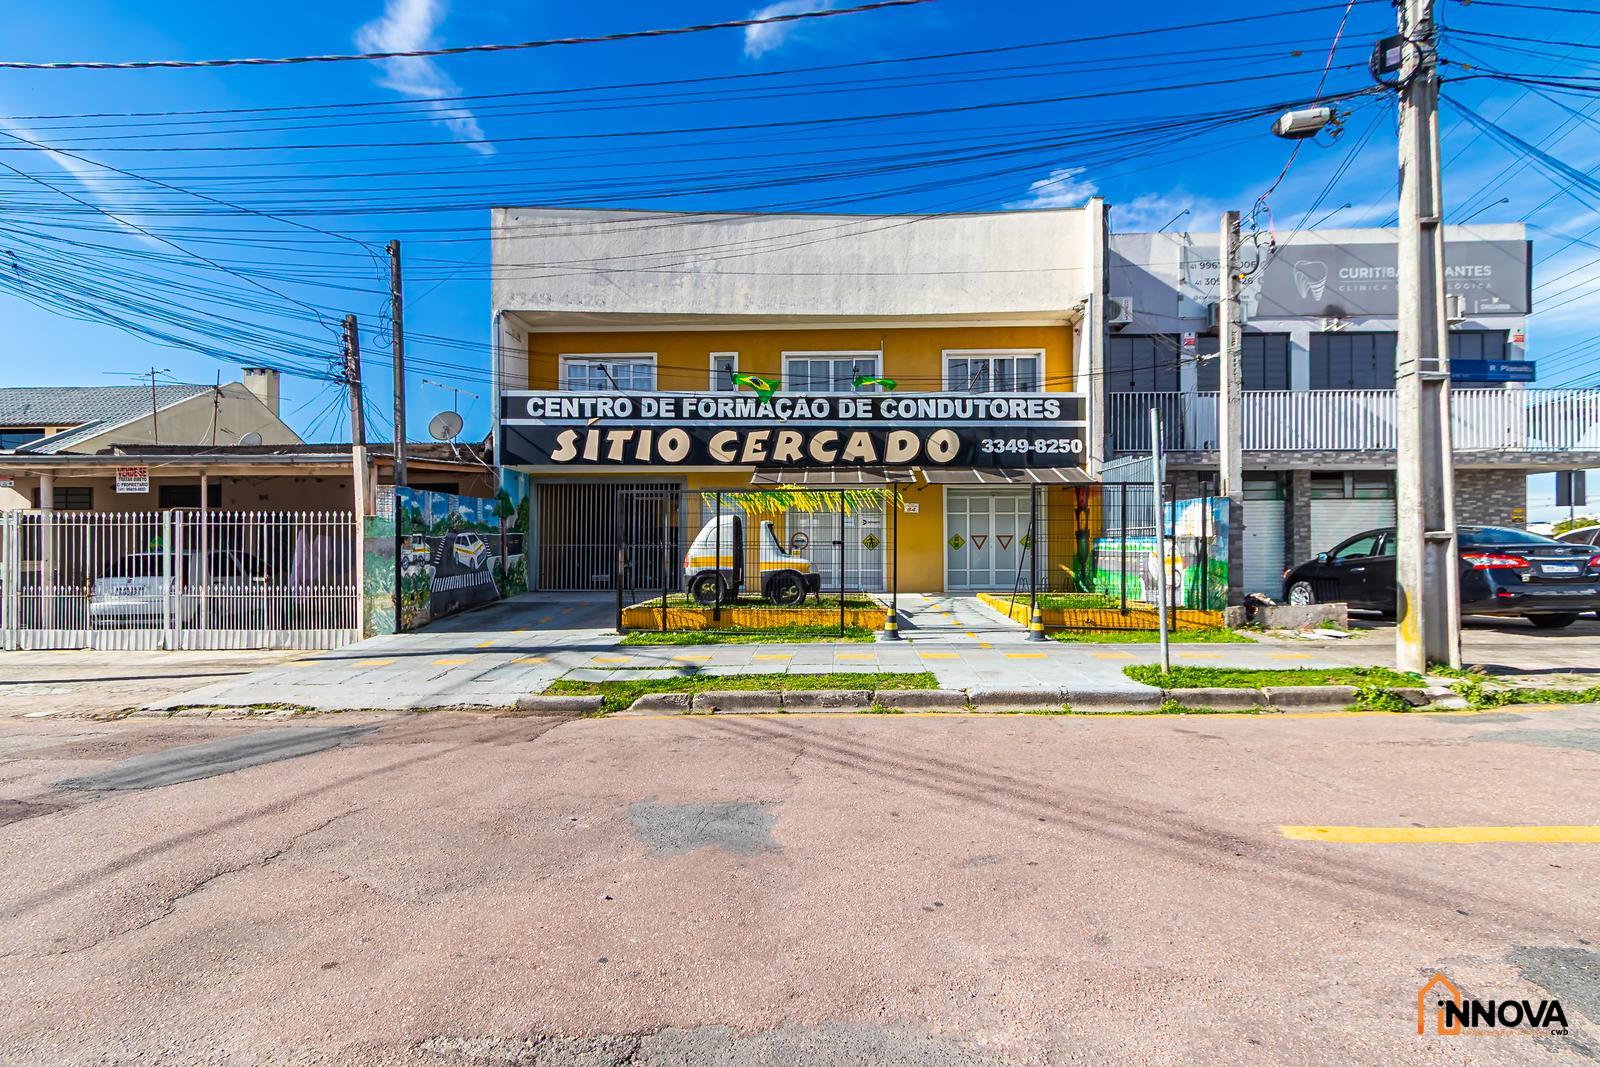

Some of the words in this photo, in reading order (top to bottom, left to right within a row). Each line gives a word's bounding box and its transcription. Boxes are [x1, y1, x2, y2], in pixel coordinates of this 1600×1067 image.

[1339, 266, 1399, 279] CURITIB
[1444, 264, 1493, 277] ANTES
[526, 397, 633, 418] CENTRO
[641, 397, 677, 418] DE
[838, 398, 873, 418] DE
[880, 398, 1061, 419] CONDUTORES
[550, 417, 691, 463] SÍTIO
[709, 428, 960, 463] CERCADO
[981, 439, 1083, 454] 3349-8250
